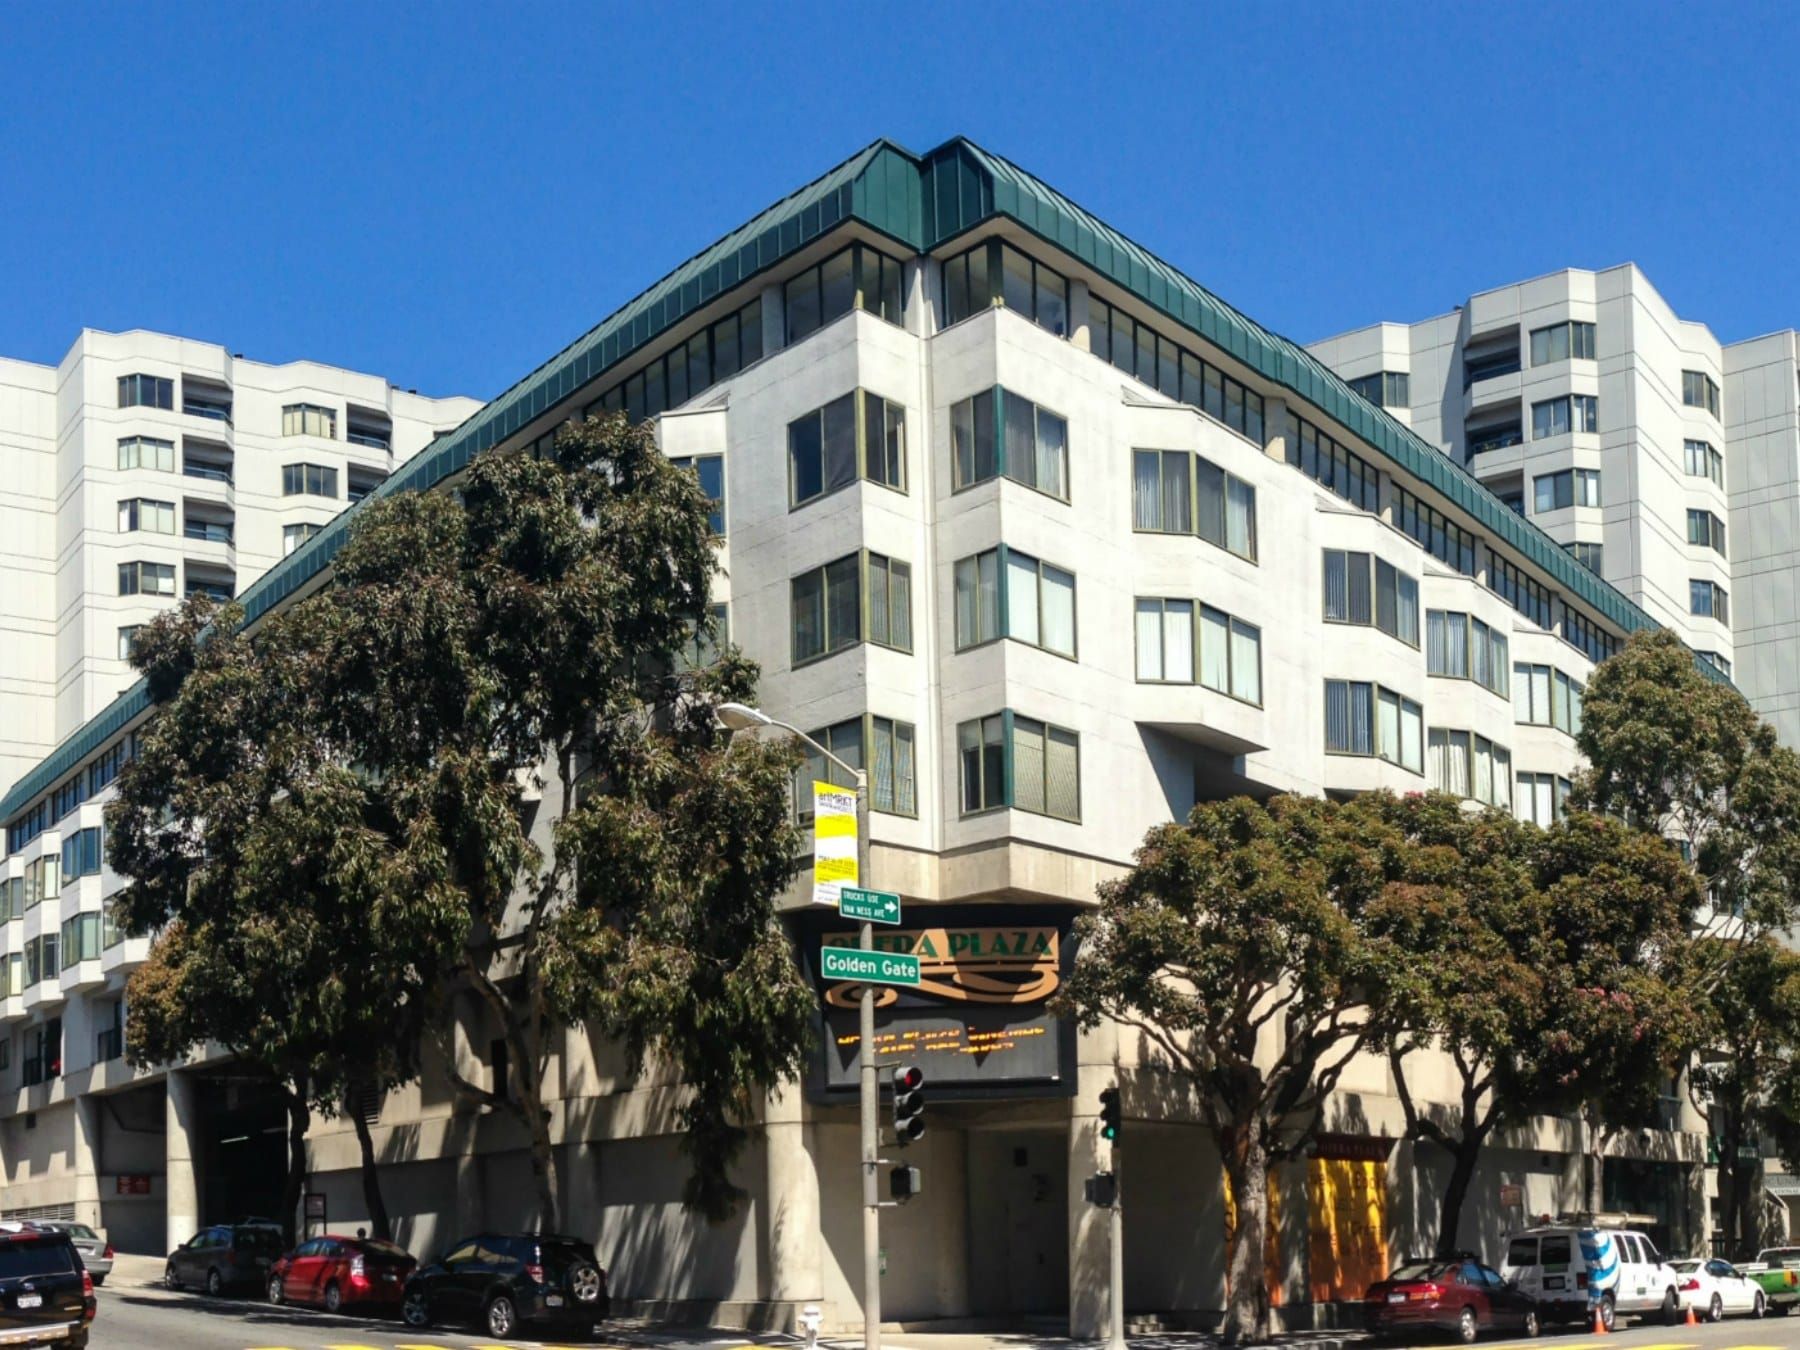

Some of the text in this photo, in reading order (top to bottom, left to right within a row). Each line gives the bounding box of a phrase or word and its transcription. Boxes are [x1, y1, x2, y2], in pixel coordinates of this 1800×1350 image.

[843, 891, 879, 904] TRUCKS USE
[843, 904, 885, 919] VAN NESS AVE
[948, 931, 1053, 958] PLAZA
[826, 955, 917, 978] Golden Gate
